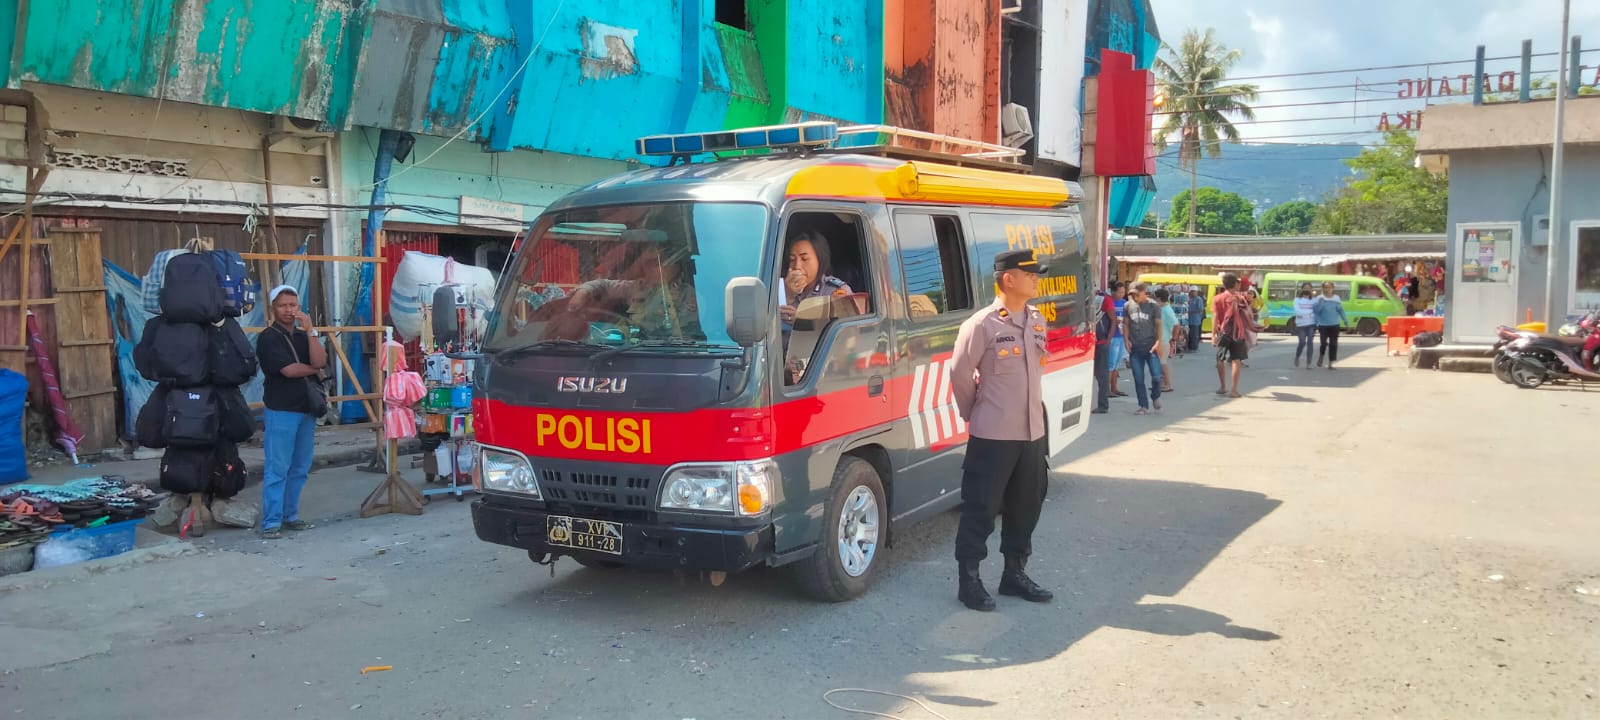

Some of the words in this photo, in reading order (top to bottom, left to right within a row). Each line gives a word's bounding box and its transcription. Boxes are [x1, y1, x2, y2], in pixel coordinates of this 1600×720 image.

[1005, 223, 1056, 255] POLISI
[557, 376, 627, 394] ISUZU
[536, 413, 652, 454] POLISI
